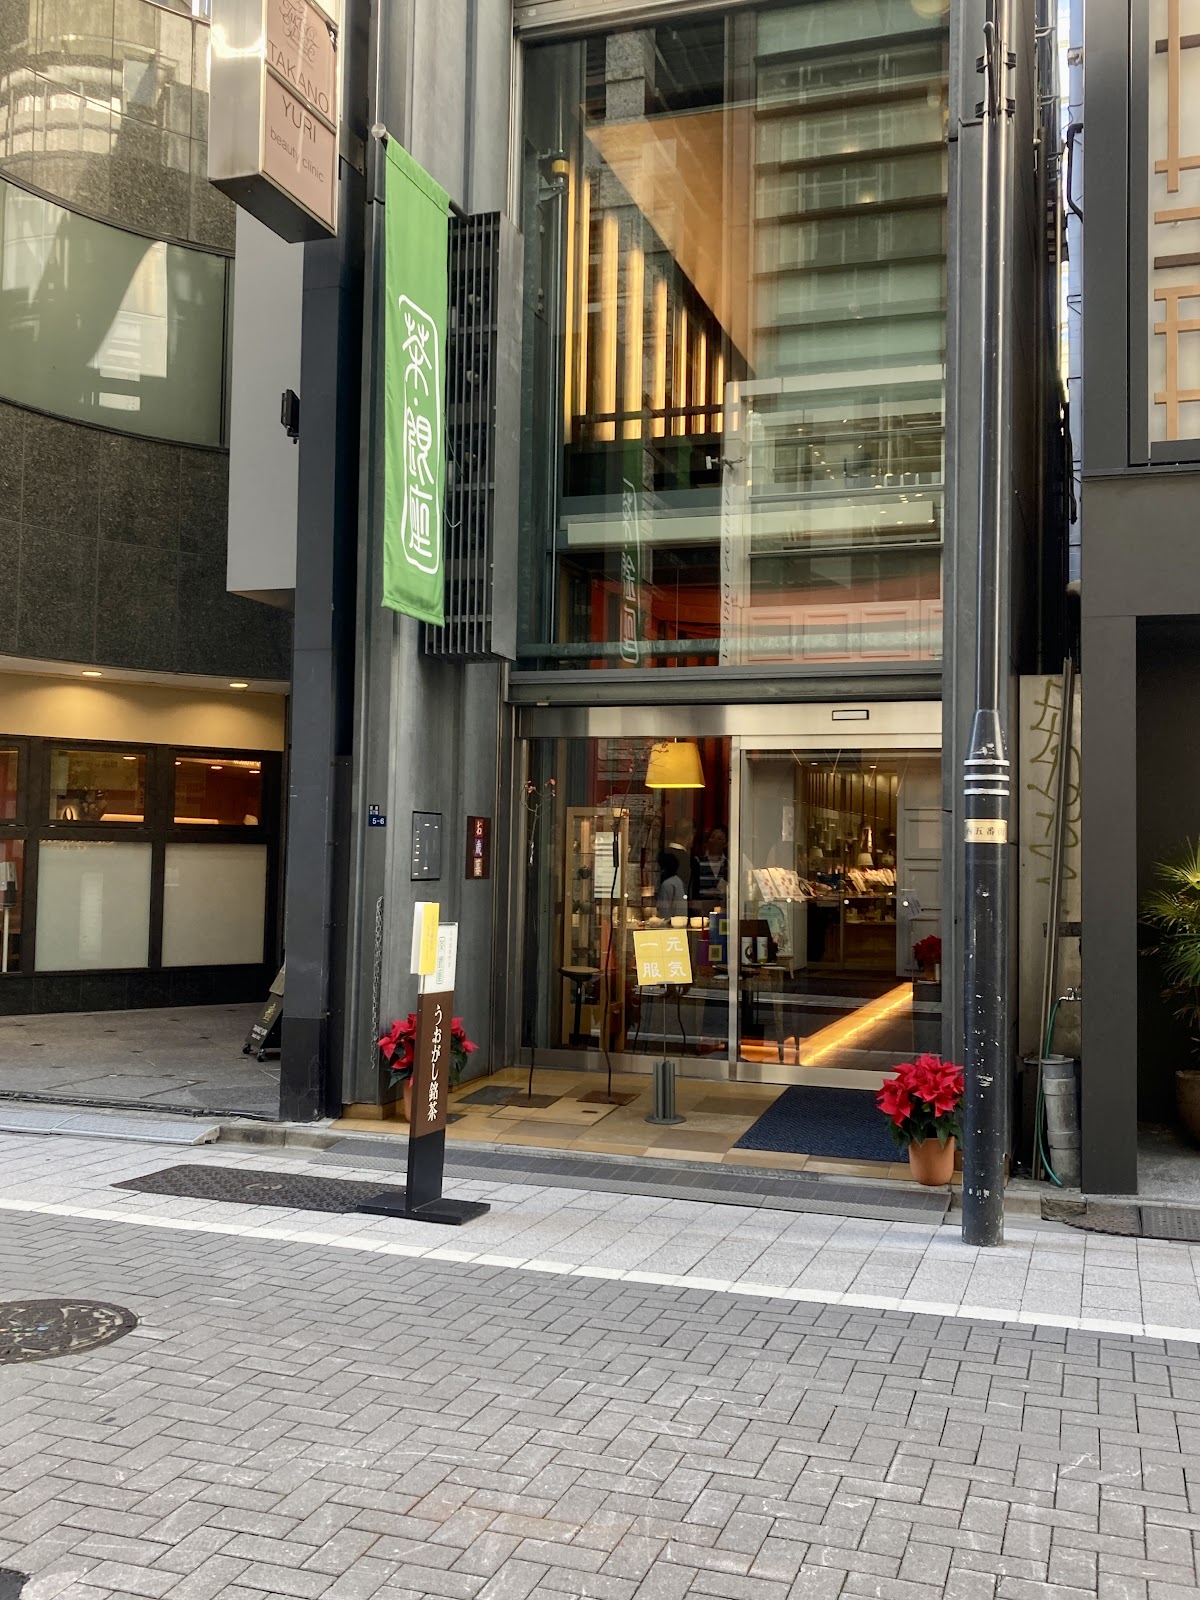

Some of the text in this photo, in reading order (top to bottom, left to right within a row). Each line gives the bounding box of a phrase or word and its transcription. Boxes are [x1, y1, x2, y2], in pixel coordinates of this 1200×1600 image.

[268, 39, 329, 114] TAKANO
[281, 94, 317, 143] YURI
[270, 125, 324, 183] beauty clinic
[372, 817, 385, 825] 5-6
[427, 1003, 443, 1122] うおがし銘茶
